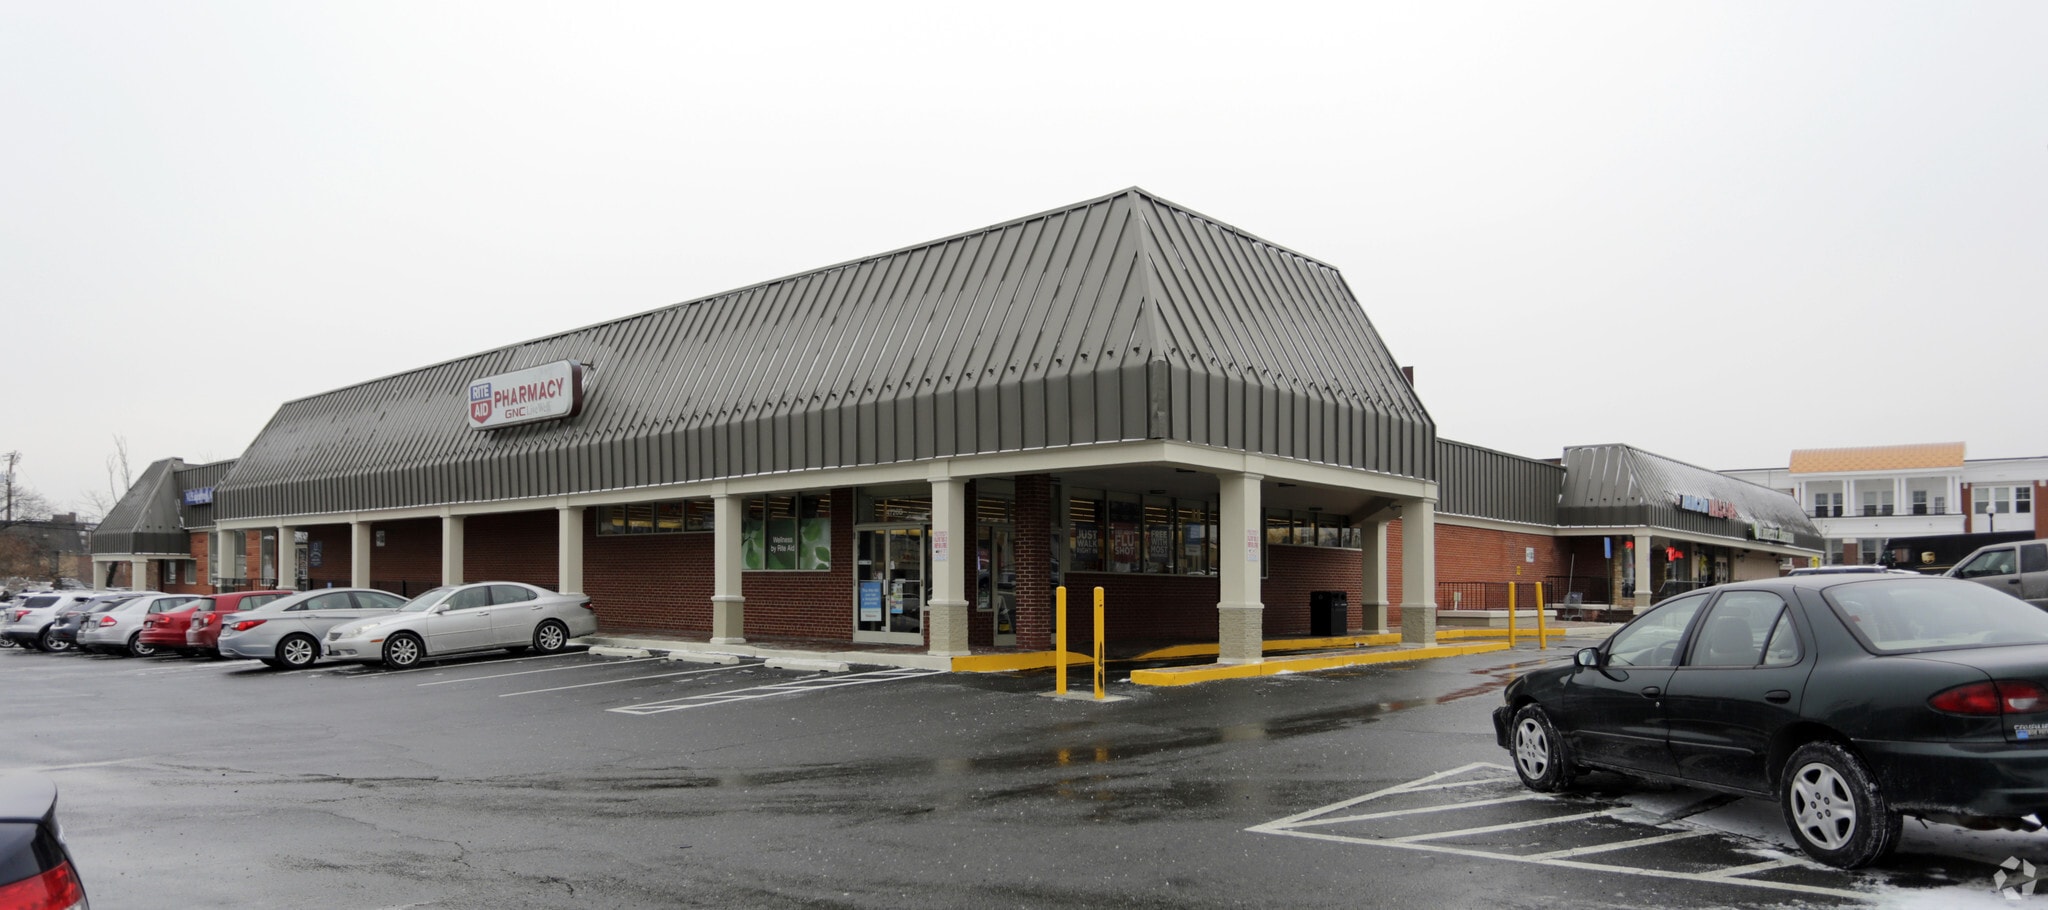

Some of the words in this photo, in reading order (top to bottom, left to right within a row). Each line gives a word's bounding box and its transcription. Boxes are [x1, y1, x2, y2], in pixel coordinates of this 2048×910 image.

[472, 384, 489, 399] RITE
[494, 377, 564, 408] PHARMACY
[474, 402, 489, 417] AID
[505, 407, 526, 419] GNC
[1077, 528, 1098, 539] JUST
[1151, 530, 1167, 538] FREE
[1077, 539, 1097, 547] WALK
[1115, 535, 1134, 546] FLU
[1151, 538, 1168, 546] WITH
[770, 545, 776, 553] by
[787, 544, 795, 552] Aid
[1115, 546, 1135, 555] SHOT
[1151, 545, 1168, 554] MOST
